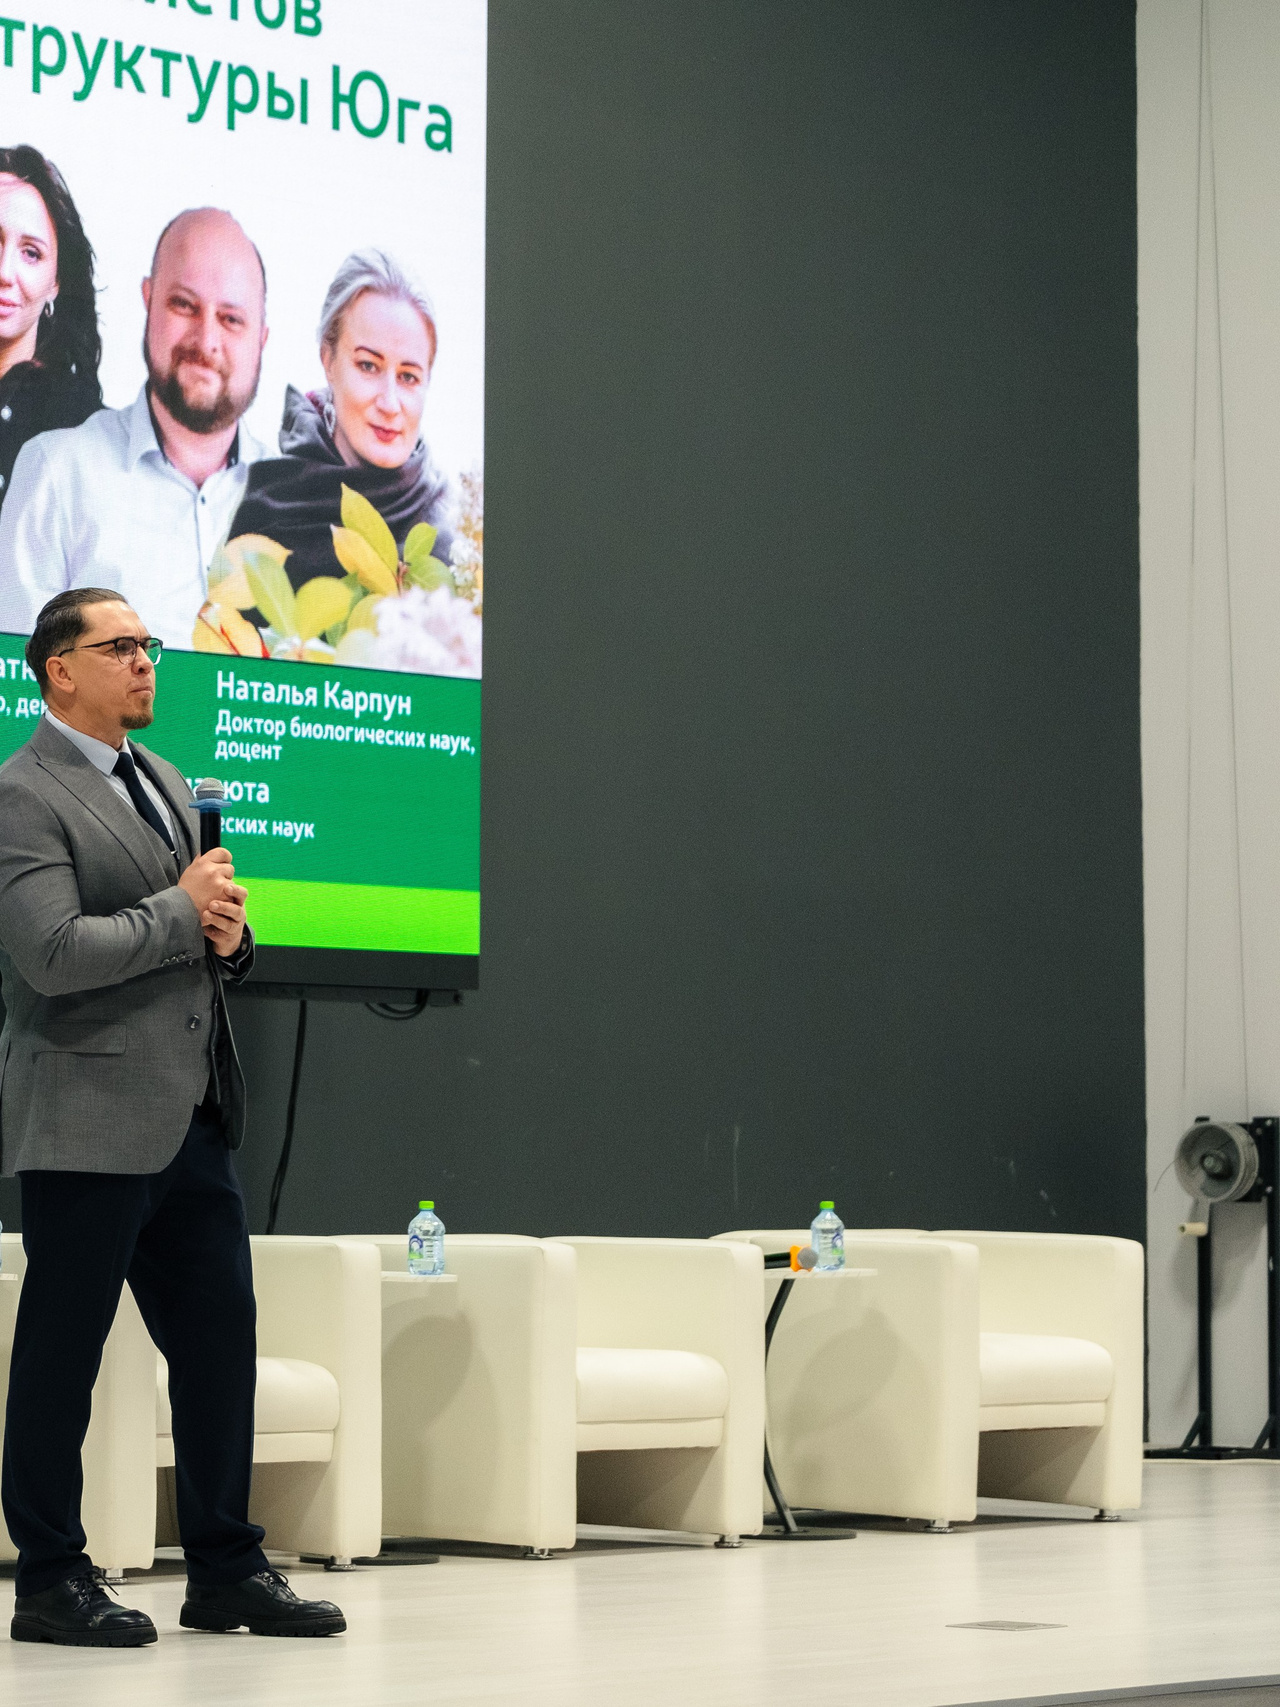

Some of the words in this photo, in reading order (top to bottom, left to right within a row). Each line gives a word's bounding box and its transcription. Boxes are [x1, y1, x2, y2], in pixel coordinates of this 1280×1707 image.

[331, 62, 454, 153] Юга
[217, 670, 318, 706] Наталья
[324, 680, 411, 721] Карпун
[214, 738, 282, 762] доцент
[215, 709, 286, 741] Доктор
[290, 717, 425, 748] биологических
[429, 734, 475, 756] наук,
[272, 821, 314, 843] наук
